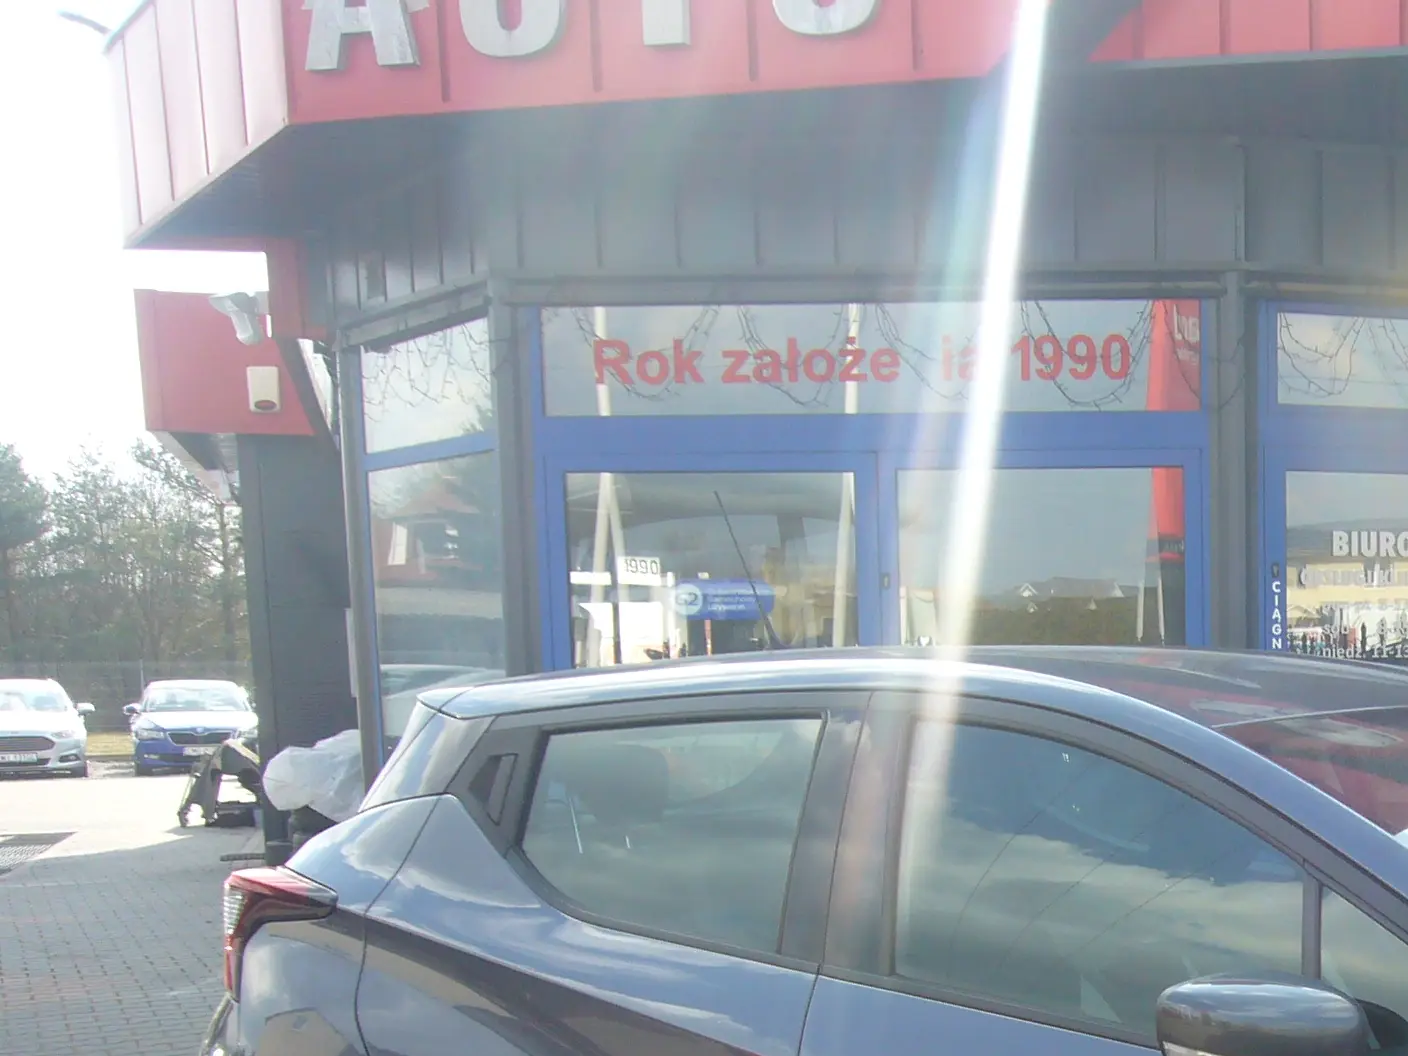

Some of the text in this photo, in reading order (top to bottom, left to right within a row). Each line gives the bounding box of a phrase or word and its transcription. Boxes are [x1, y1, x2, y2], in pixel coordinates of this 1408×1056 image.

[304, 0, 878, 71] AU
[593, 333, 1132, 384] Rok założeia 1990
